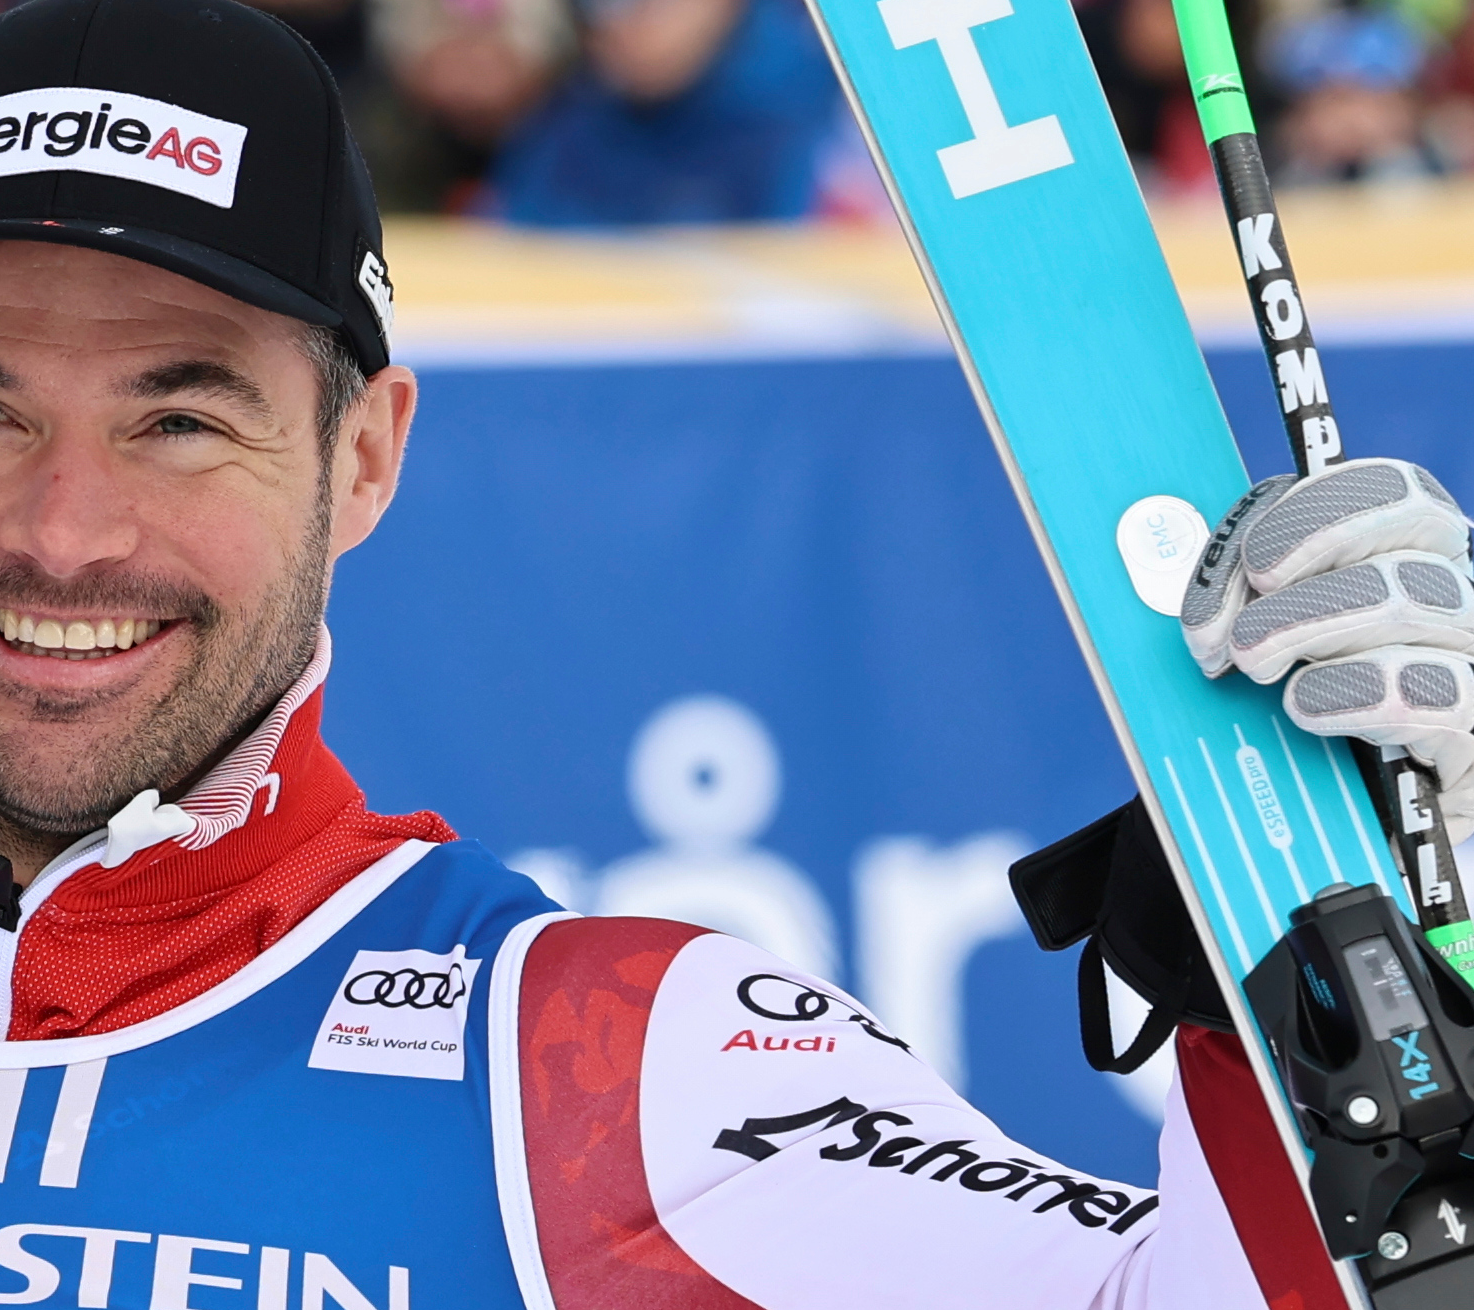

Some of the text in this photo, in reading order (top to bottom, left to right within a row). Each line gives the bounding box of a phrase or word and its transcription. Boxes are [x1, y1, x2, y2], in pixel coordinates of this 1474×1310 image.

[1147, 513, 1177, 559] EMC
[1197, 480, 1276, 587] reusc
[327, 1034, 457, 1053] FIS Ski World Cup
[331, 1022, 370, 1035] Audi
[720, 1029, 836, 1053] Audi
[1391, 1030, 1440, 1101] 14X
